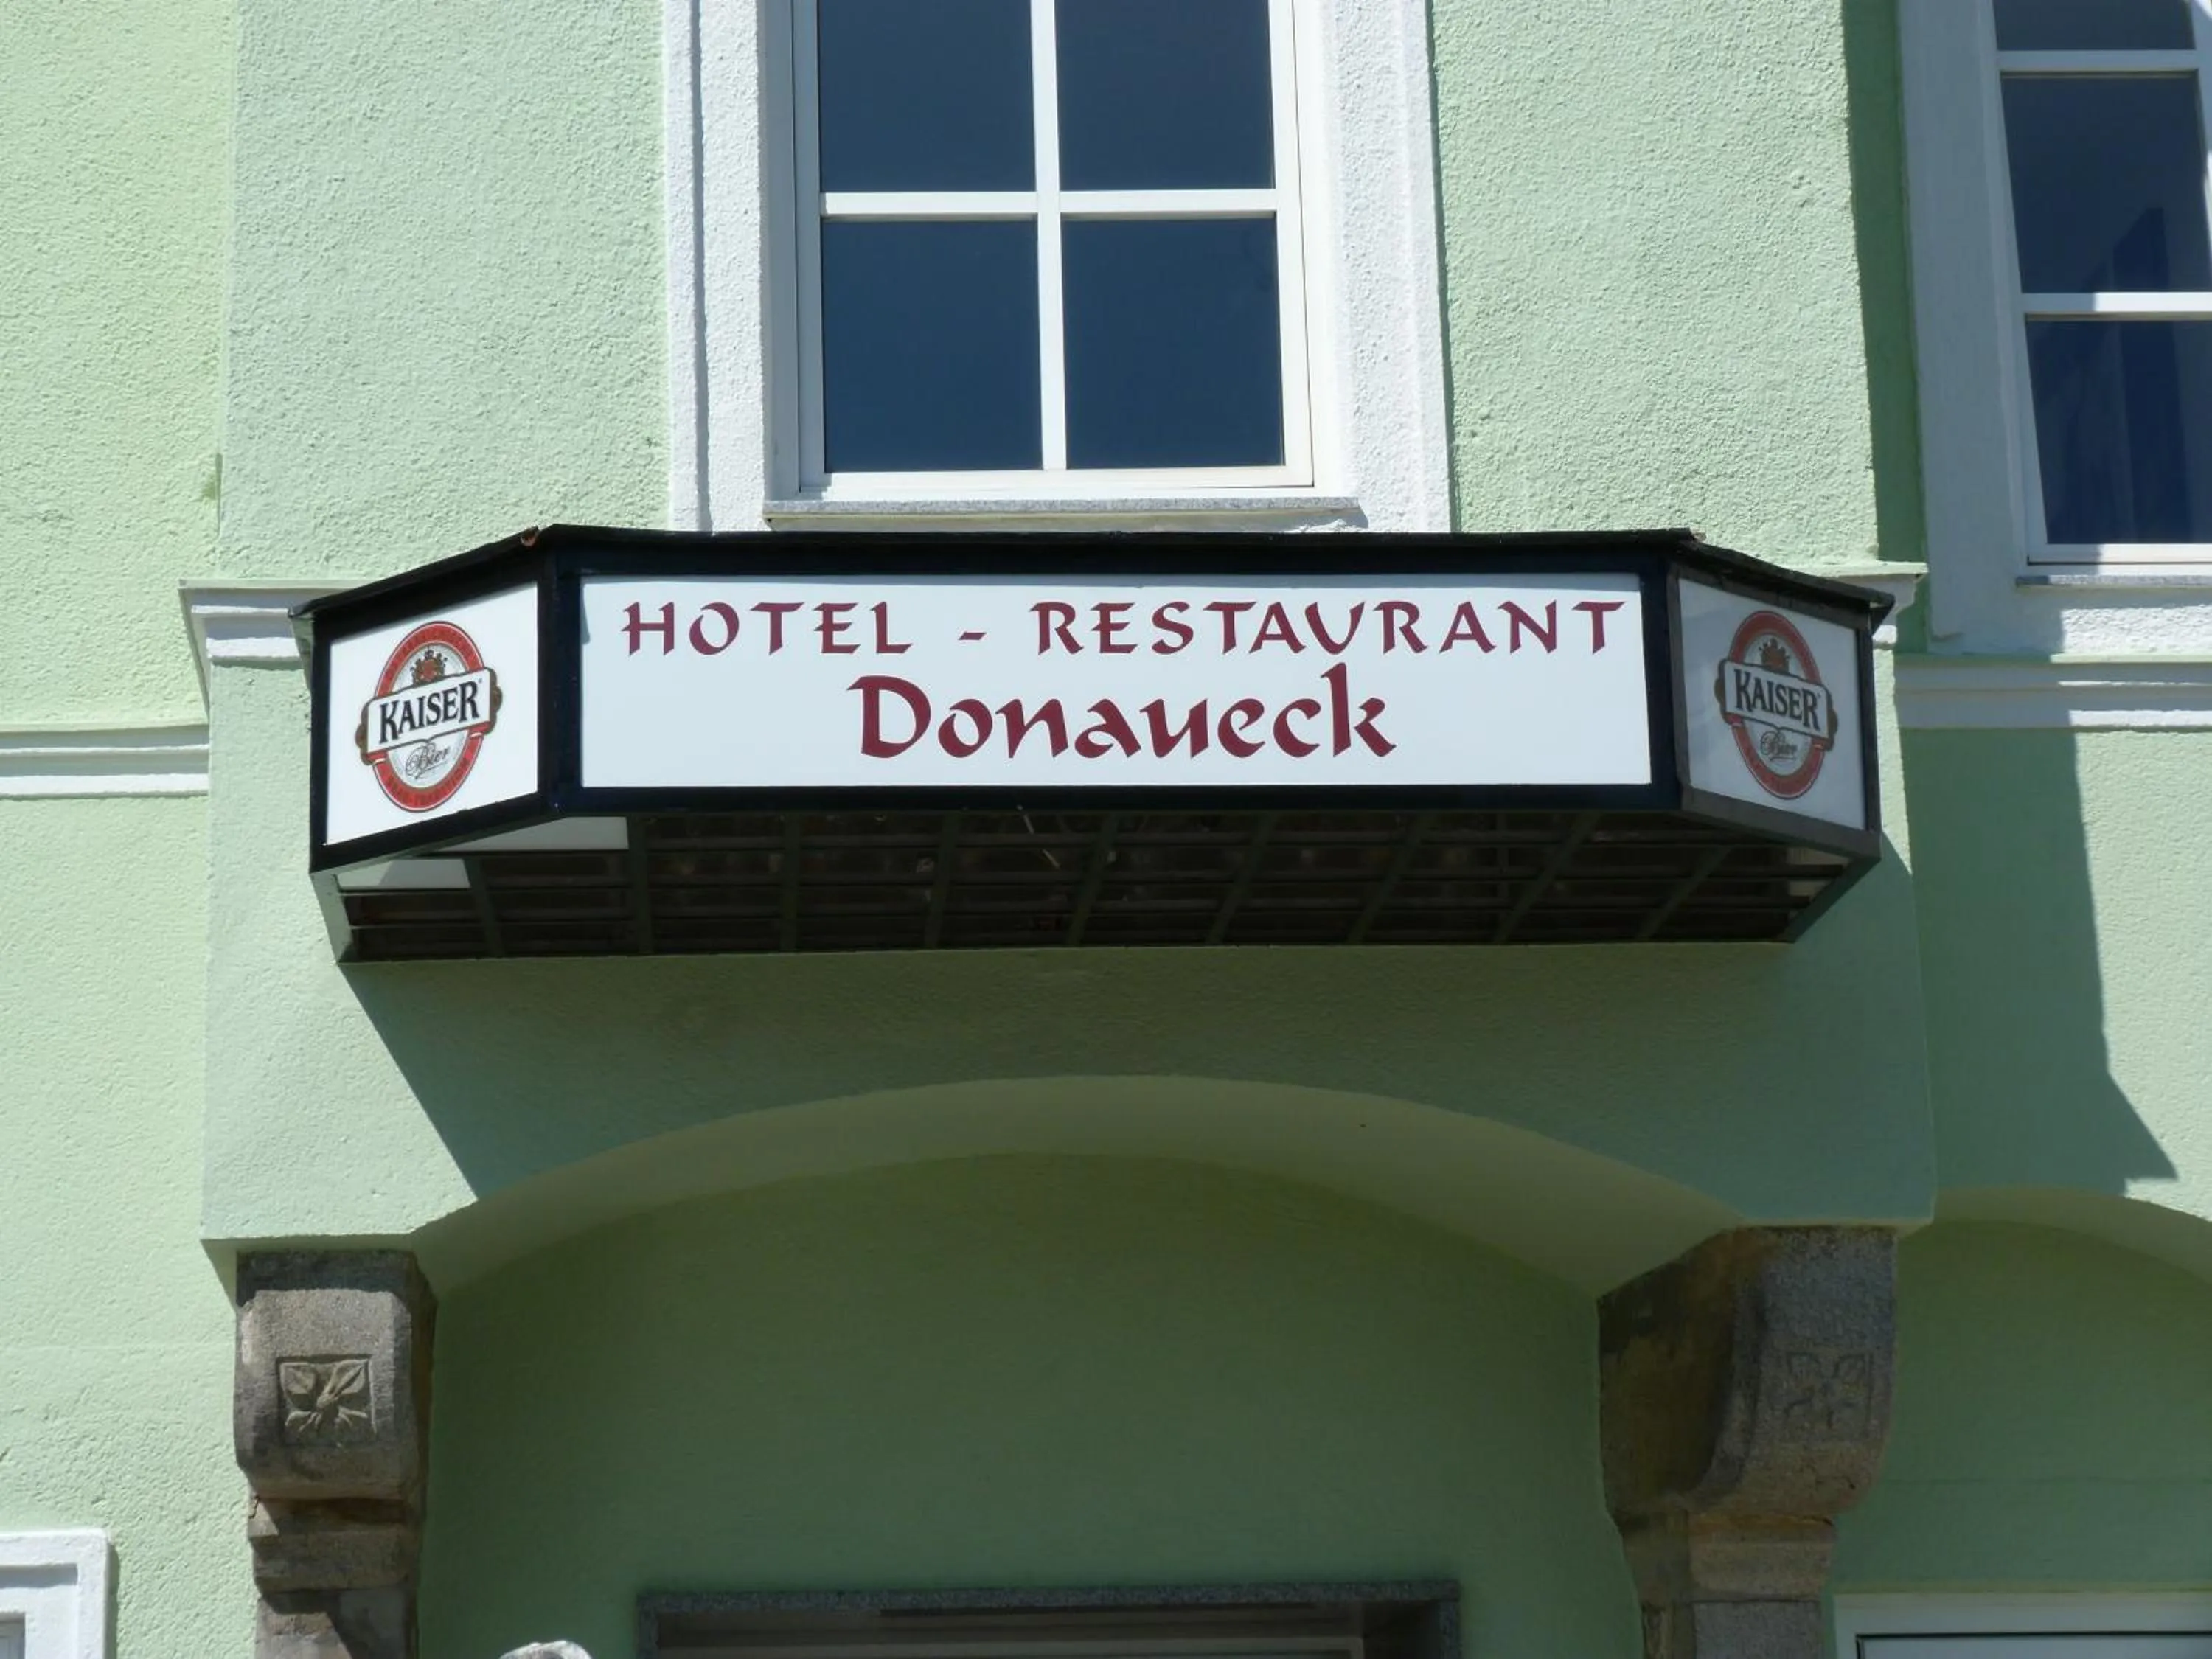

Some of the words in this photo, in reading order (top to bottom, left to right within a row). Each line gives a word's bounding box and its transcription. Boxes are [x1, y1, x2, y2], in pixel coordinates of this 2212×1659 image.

[622, 602, 915, 654] HOTEL
[958, 631, 987, 642] -
[1029, 601, 1625, 654] RESTAURANT
[379, 681, 479, 744] KAISER
[846, 661, 1397, 759] Donaueck
[1734, 669, 1820, 730] KAISER
